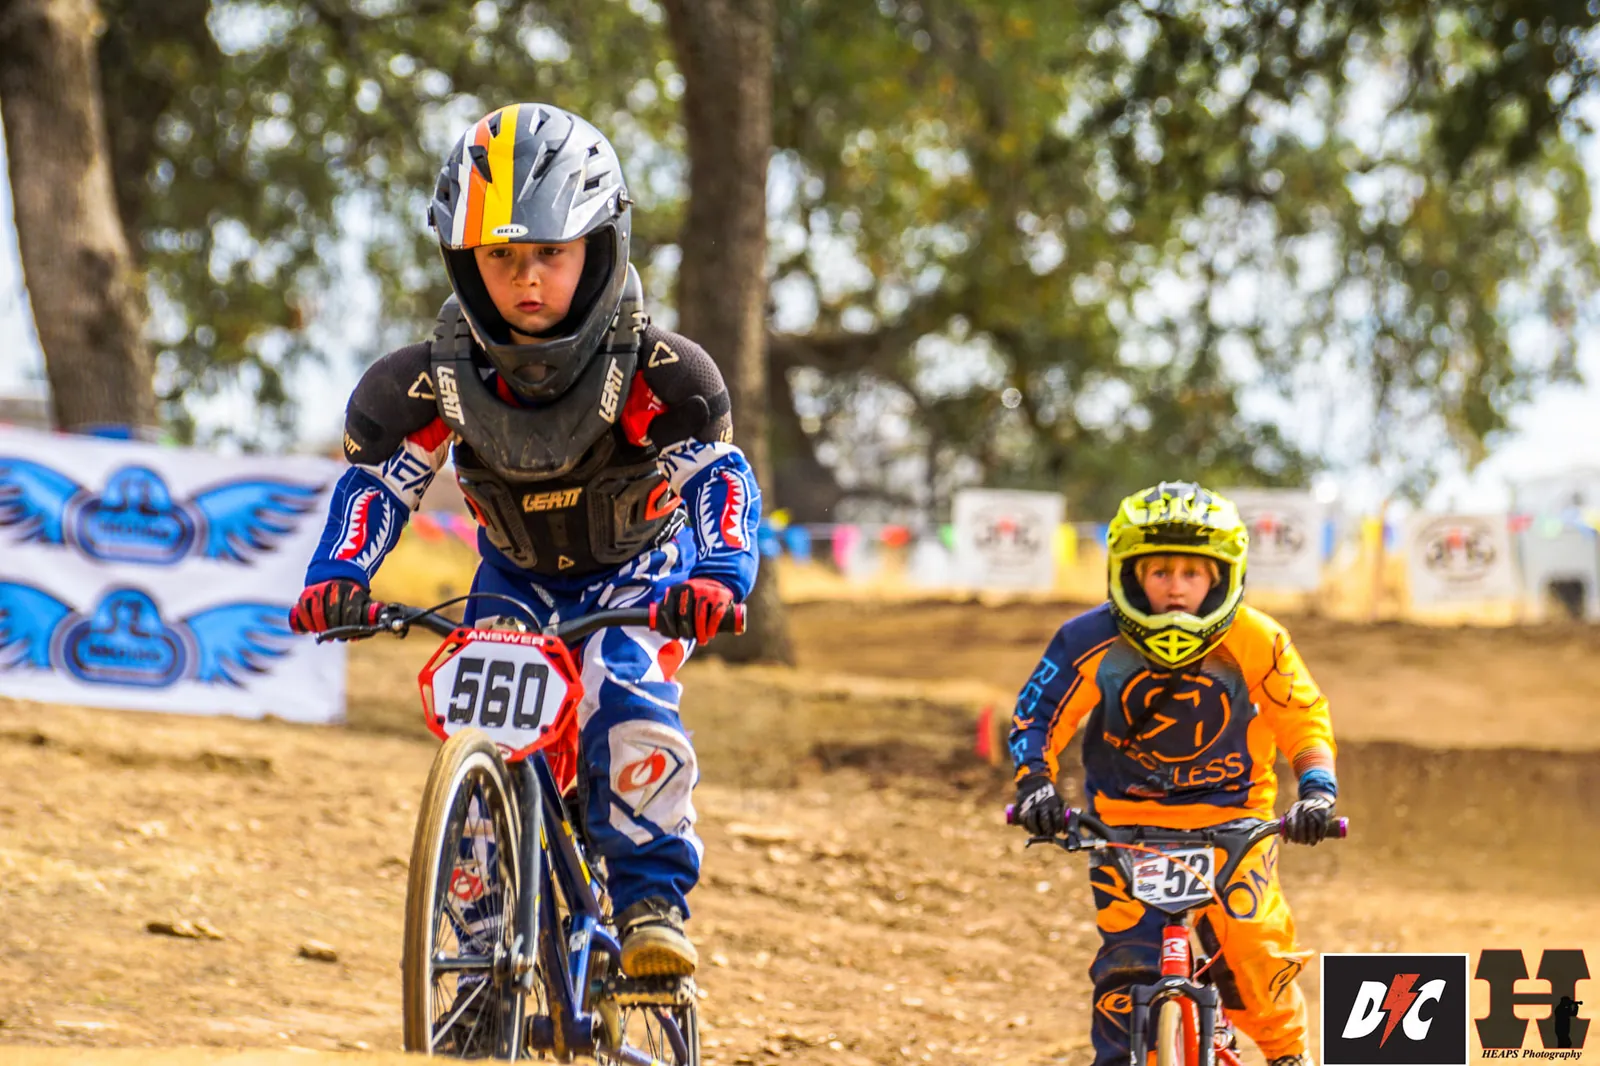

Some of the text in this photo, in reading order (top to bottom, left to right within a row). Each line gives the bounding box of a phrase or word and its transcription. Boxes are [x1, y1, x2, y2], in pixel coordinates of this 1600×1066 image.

[436, 365, 466, 425] LEATT
[598, 356, 625, 424] LEATT
[522, 486, 583, 513] LEATT
[466, 630, 546, 647] ANSWER
[447, 656, 550, 731] 560
[1163, 852, 1211, 899] 52
